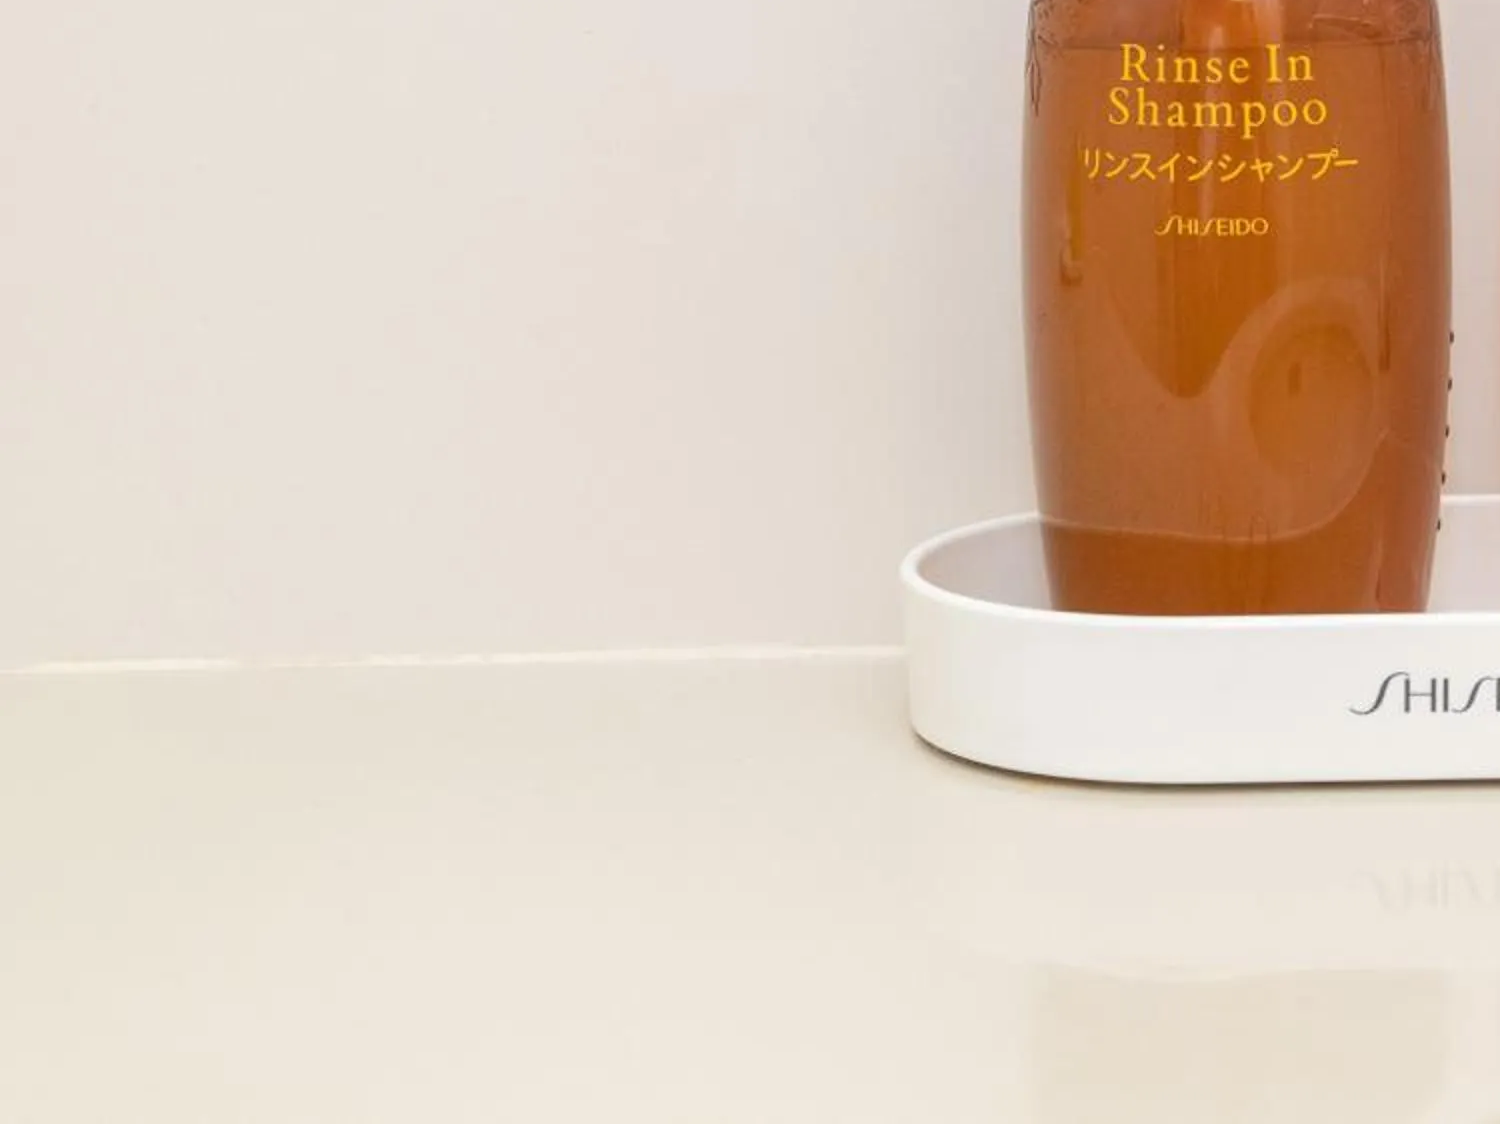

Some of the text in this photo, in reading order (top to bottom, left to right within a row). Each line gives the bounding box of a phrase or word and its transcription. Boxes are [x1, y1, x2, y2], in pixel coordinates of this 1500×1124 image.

[1119, 42, 1316, 84] Rinse In
[1107, 86, 1328, 141] Shampoo
[1083, 146, 1360, 184] リンスインシャンプー
[1153, 213, 1270, 237] SHISEIDO
